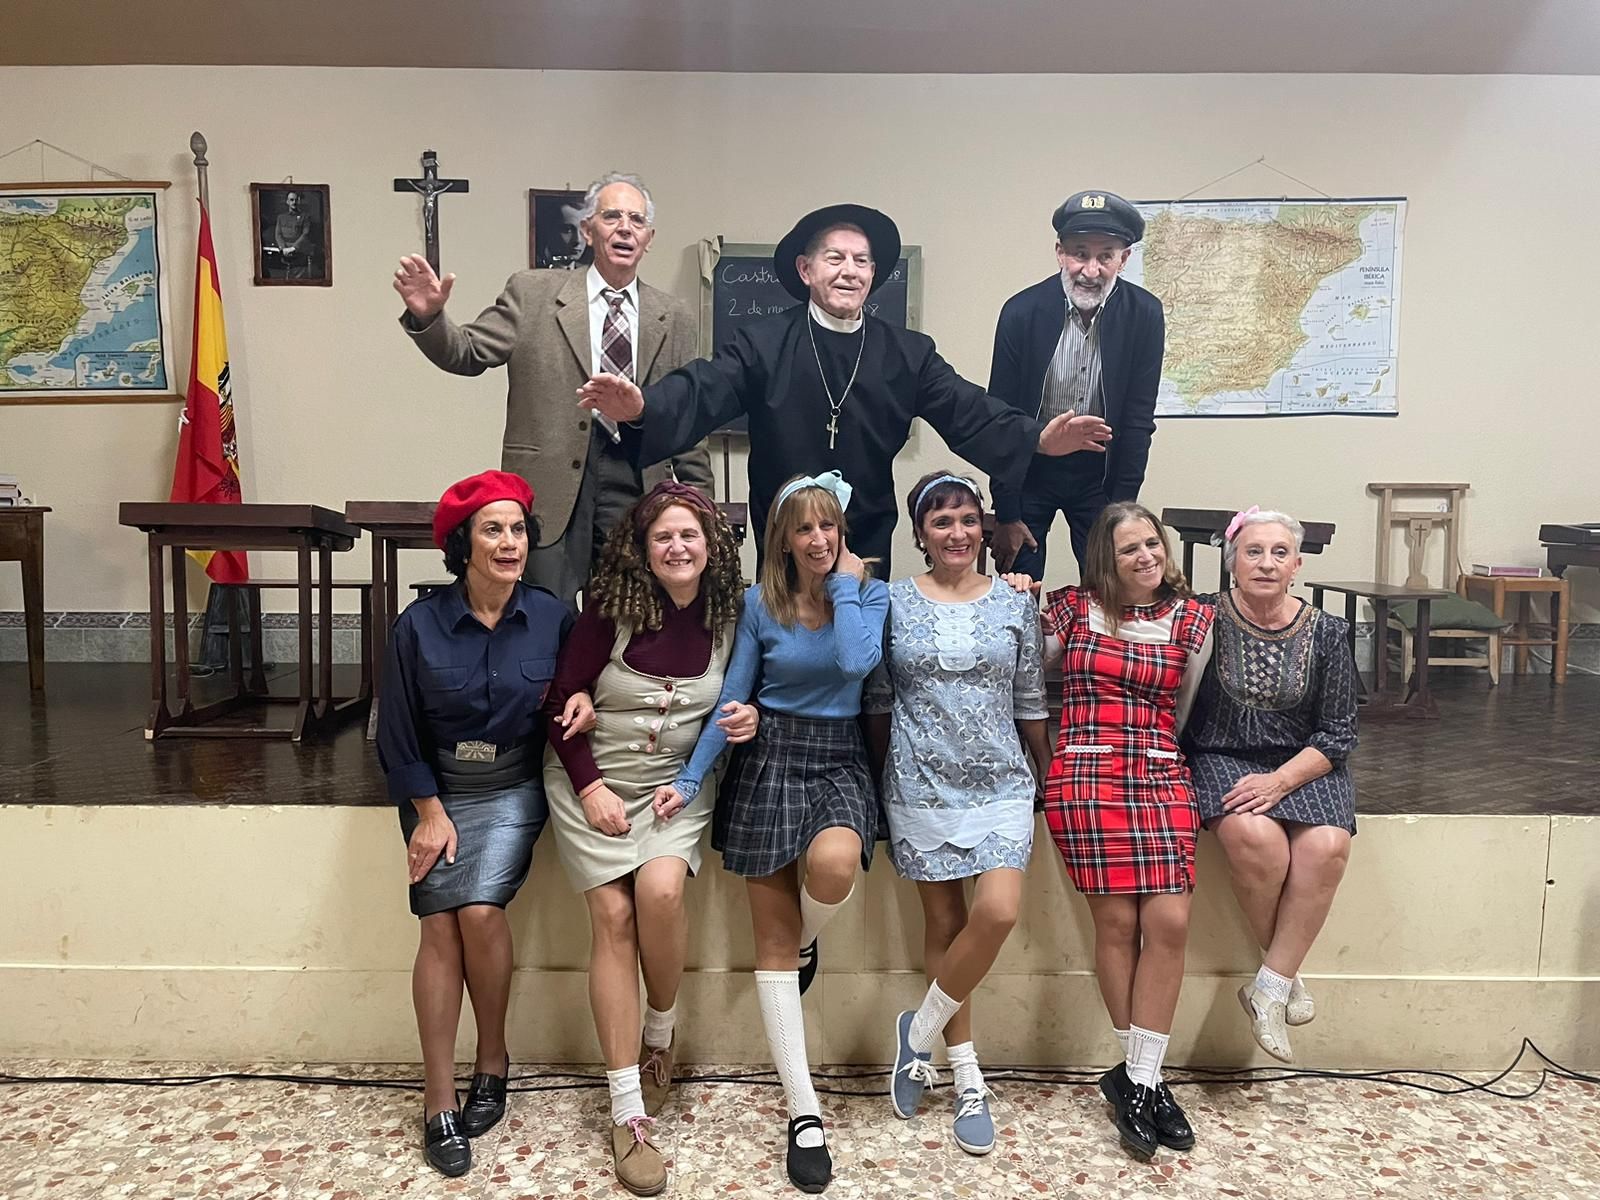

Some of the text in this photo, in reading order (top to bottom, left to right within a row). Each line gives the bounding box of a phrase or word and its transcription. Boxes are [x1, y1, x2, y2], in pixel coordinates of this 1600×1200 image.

[722, 263, 780, 284] Castr
[728, 298, 741, 316] 2
[747, 299, 762, 315] de
